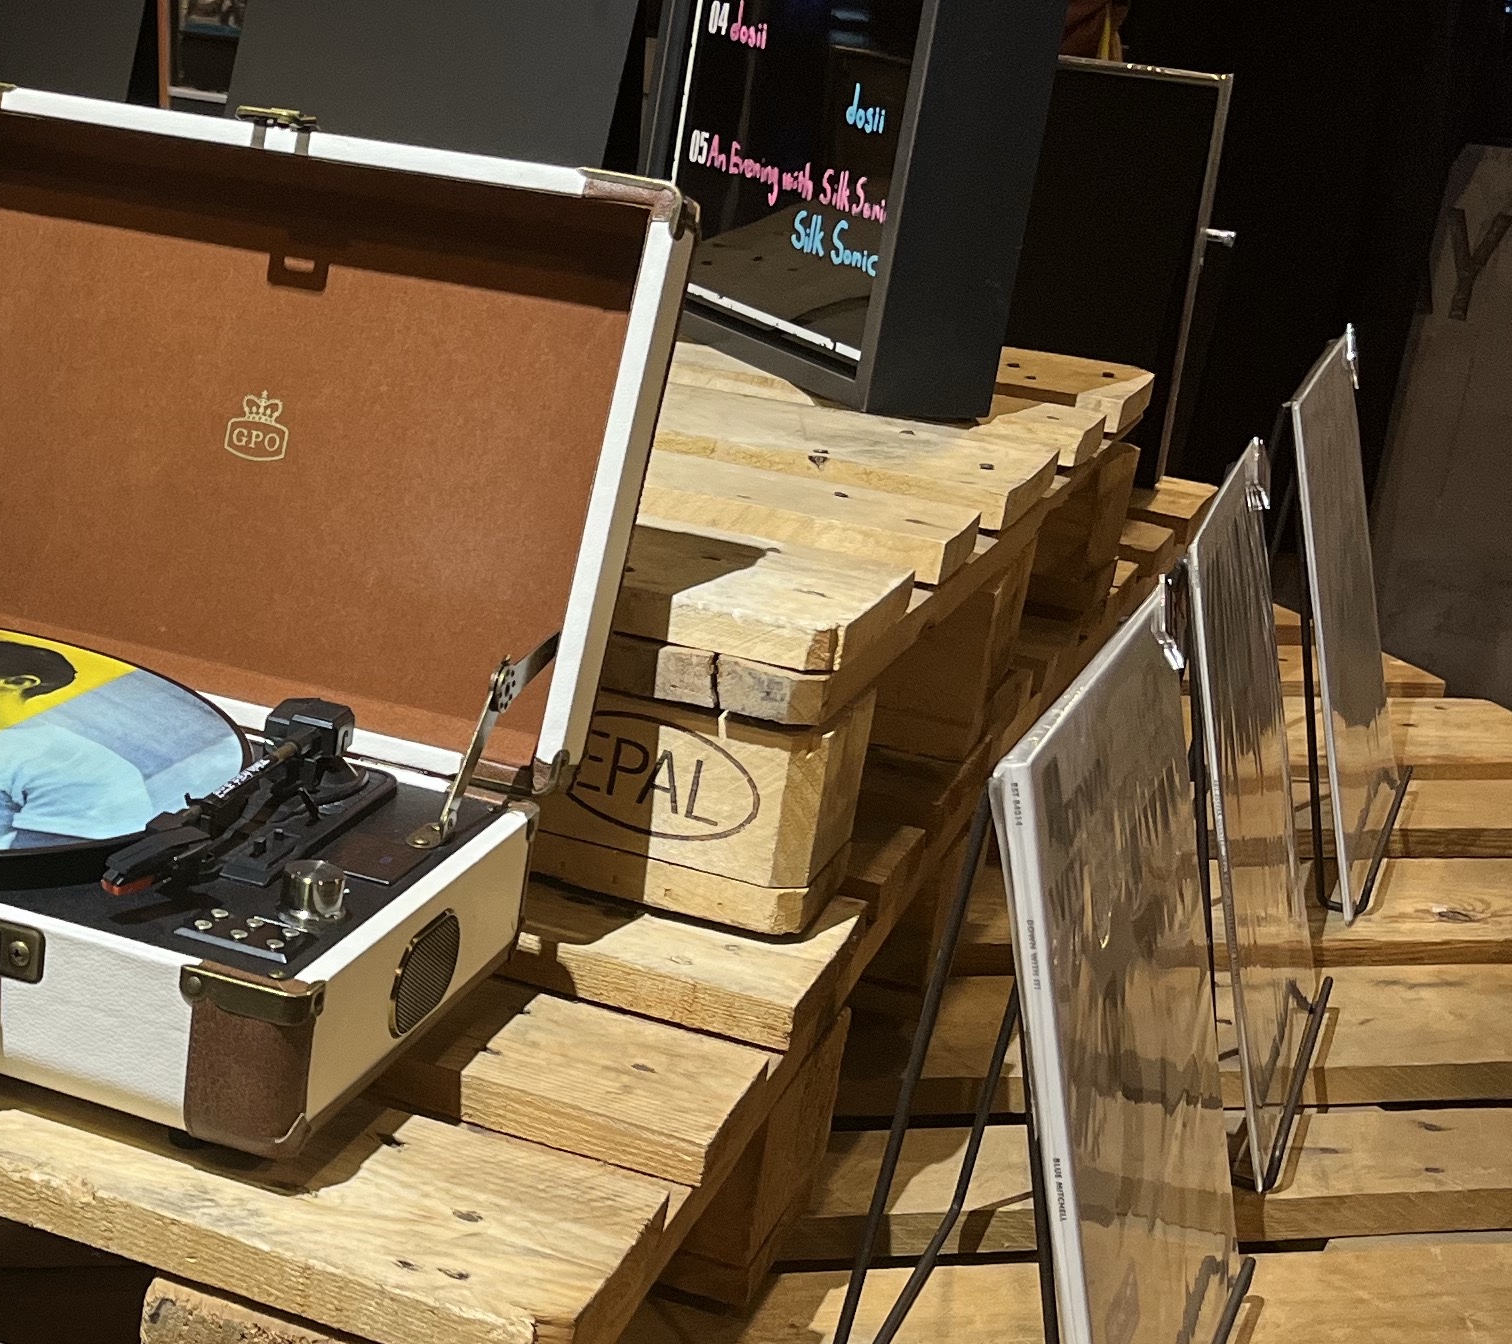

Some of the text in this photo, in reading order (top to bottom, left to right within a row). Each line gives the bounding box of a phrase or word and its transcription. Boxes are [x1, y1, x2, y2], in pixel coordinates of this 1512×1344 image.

[708, 0, 767, 50] 04 dosii
[845, 82, 886, 134] dosii
[689, 129, 887, 224] 05 An Evening with Silk Soni
[791, 210, 880, 278] Silk Sonic
[232, 428, 280, 451] GPO
[1053, 1158, 1067, 1222] BLUE MITCHELL
